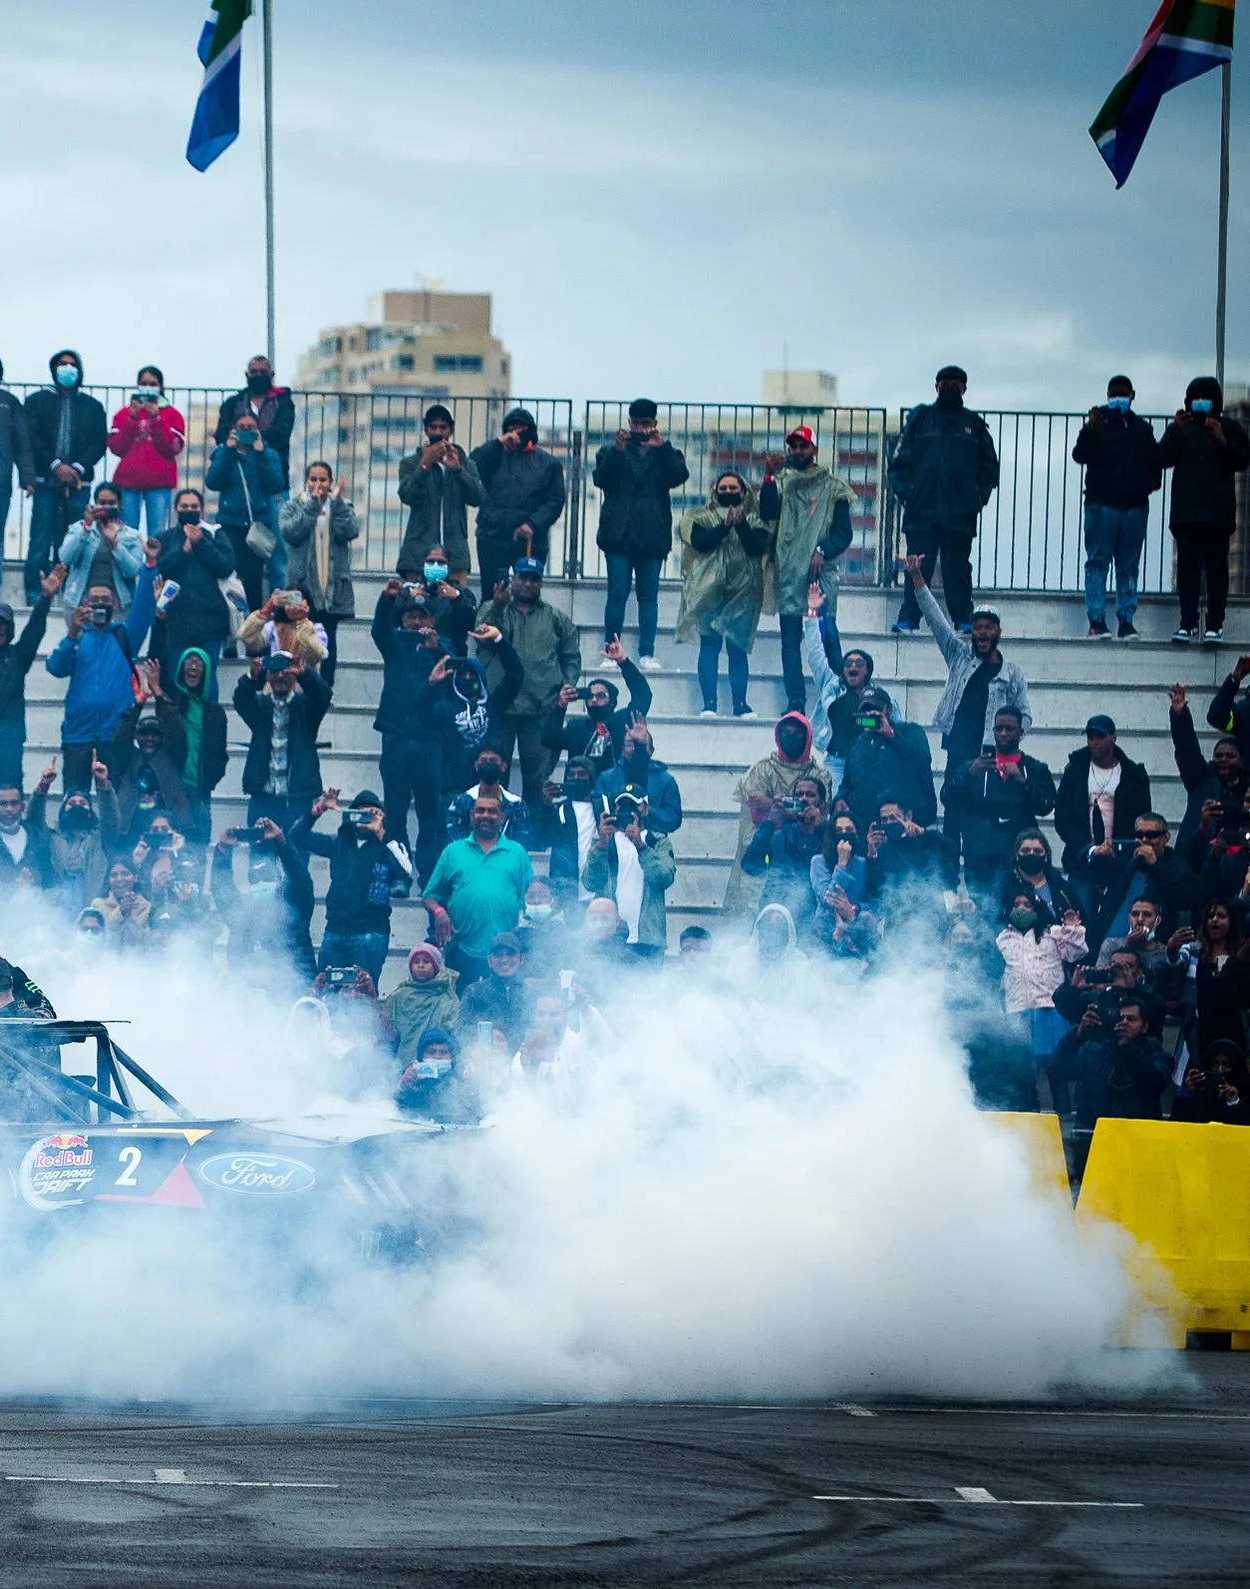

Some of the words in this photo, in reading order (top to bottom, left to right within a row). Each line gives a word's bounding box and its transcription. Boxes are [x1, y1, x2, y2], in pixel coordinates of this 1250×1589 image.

[35, 1151, 63, 1167] Red
[64, 1149, 93, 1166] Bull
[114, 1146, 142, 1186] 2
[33, 1172, 59, 1181] CAR
[59, 1168, 96, 1180] PARK
[221, 1158, 294, 1190] Ford
[33, 1177, 94, 1194] DRIFT
